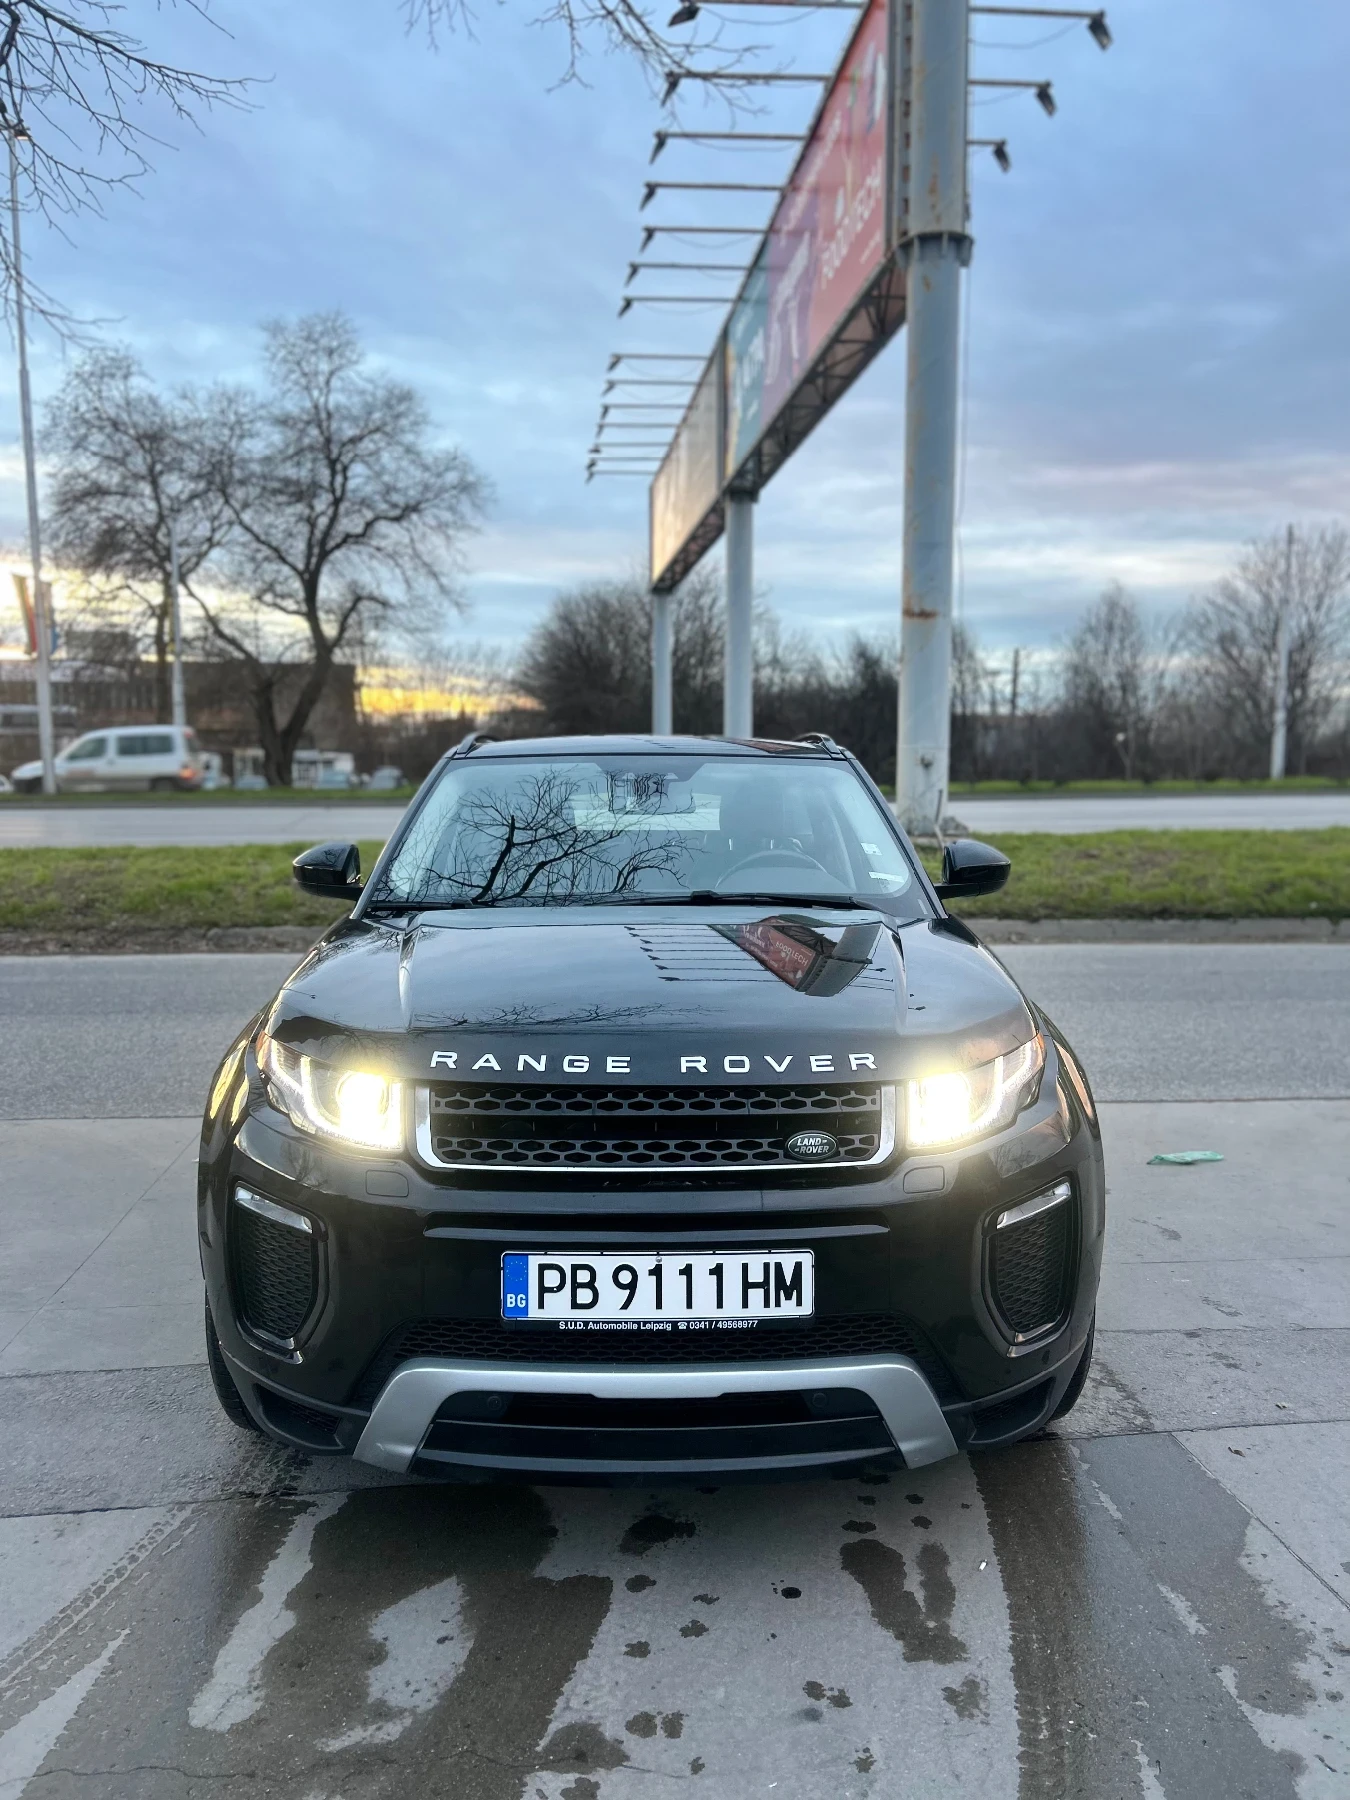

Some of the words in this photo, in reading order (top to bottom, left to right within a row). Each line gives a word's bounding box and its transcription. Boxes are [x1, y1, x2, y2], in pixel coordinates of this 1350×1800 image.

[430, 1051, 631, 1073] RANGE
[680, 1053, 878, 1073] ROVER
[797, 1138, 822, 1146] LAND
[800, 1145, 830, 1154] ROVER
[537, 1263, 600, 1310] PB
[612, 1262, 724, 1310] 9111
[741, 1261, 803, 1309] HM
[506, 1293, 526, 1308] BG
[559, 1321, 586, 1330] S.U.D.
[588, 1321, 638, 1330] Automobile
[640, 1321, 672, 1332] Leipzig
[689, 1320, 709, 1330] 0341
[717, 1320, 759, 1329] 49568977
